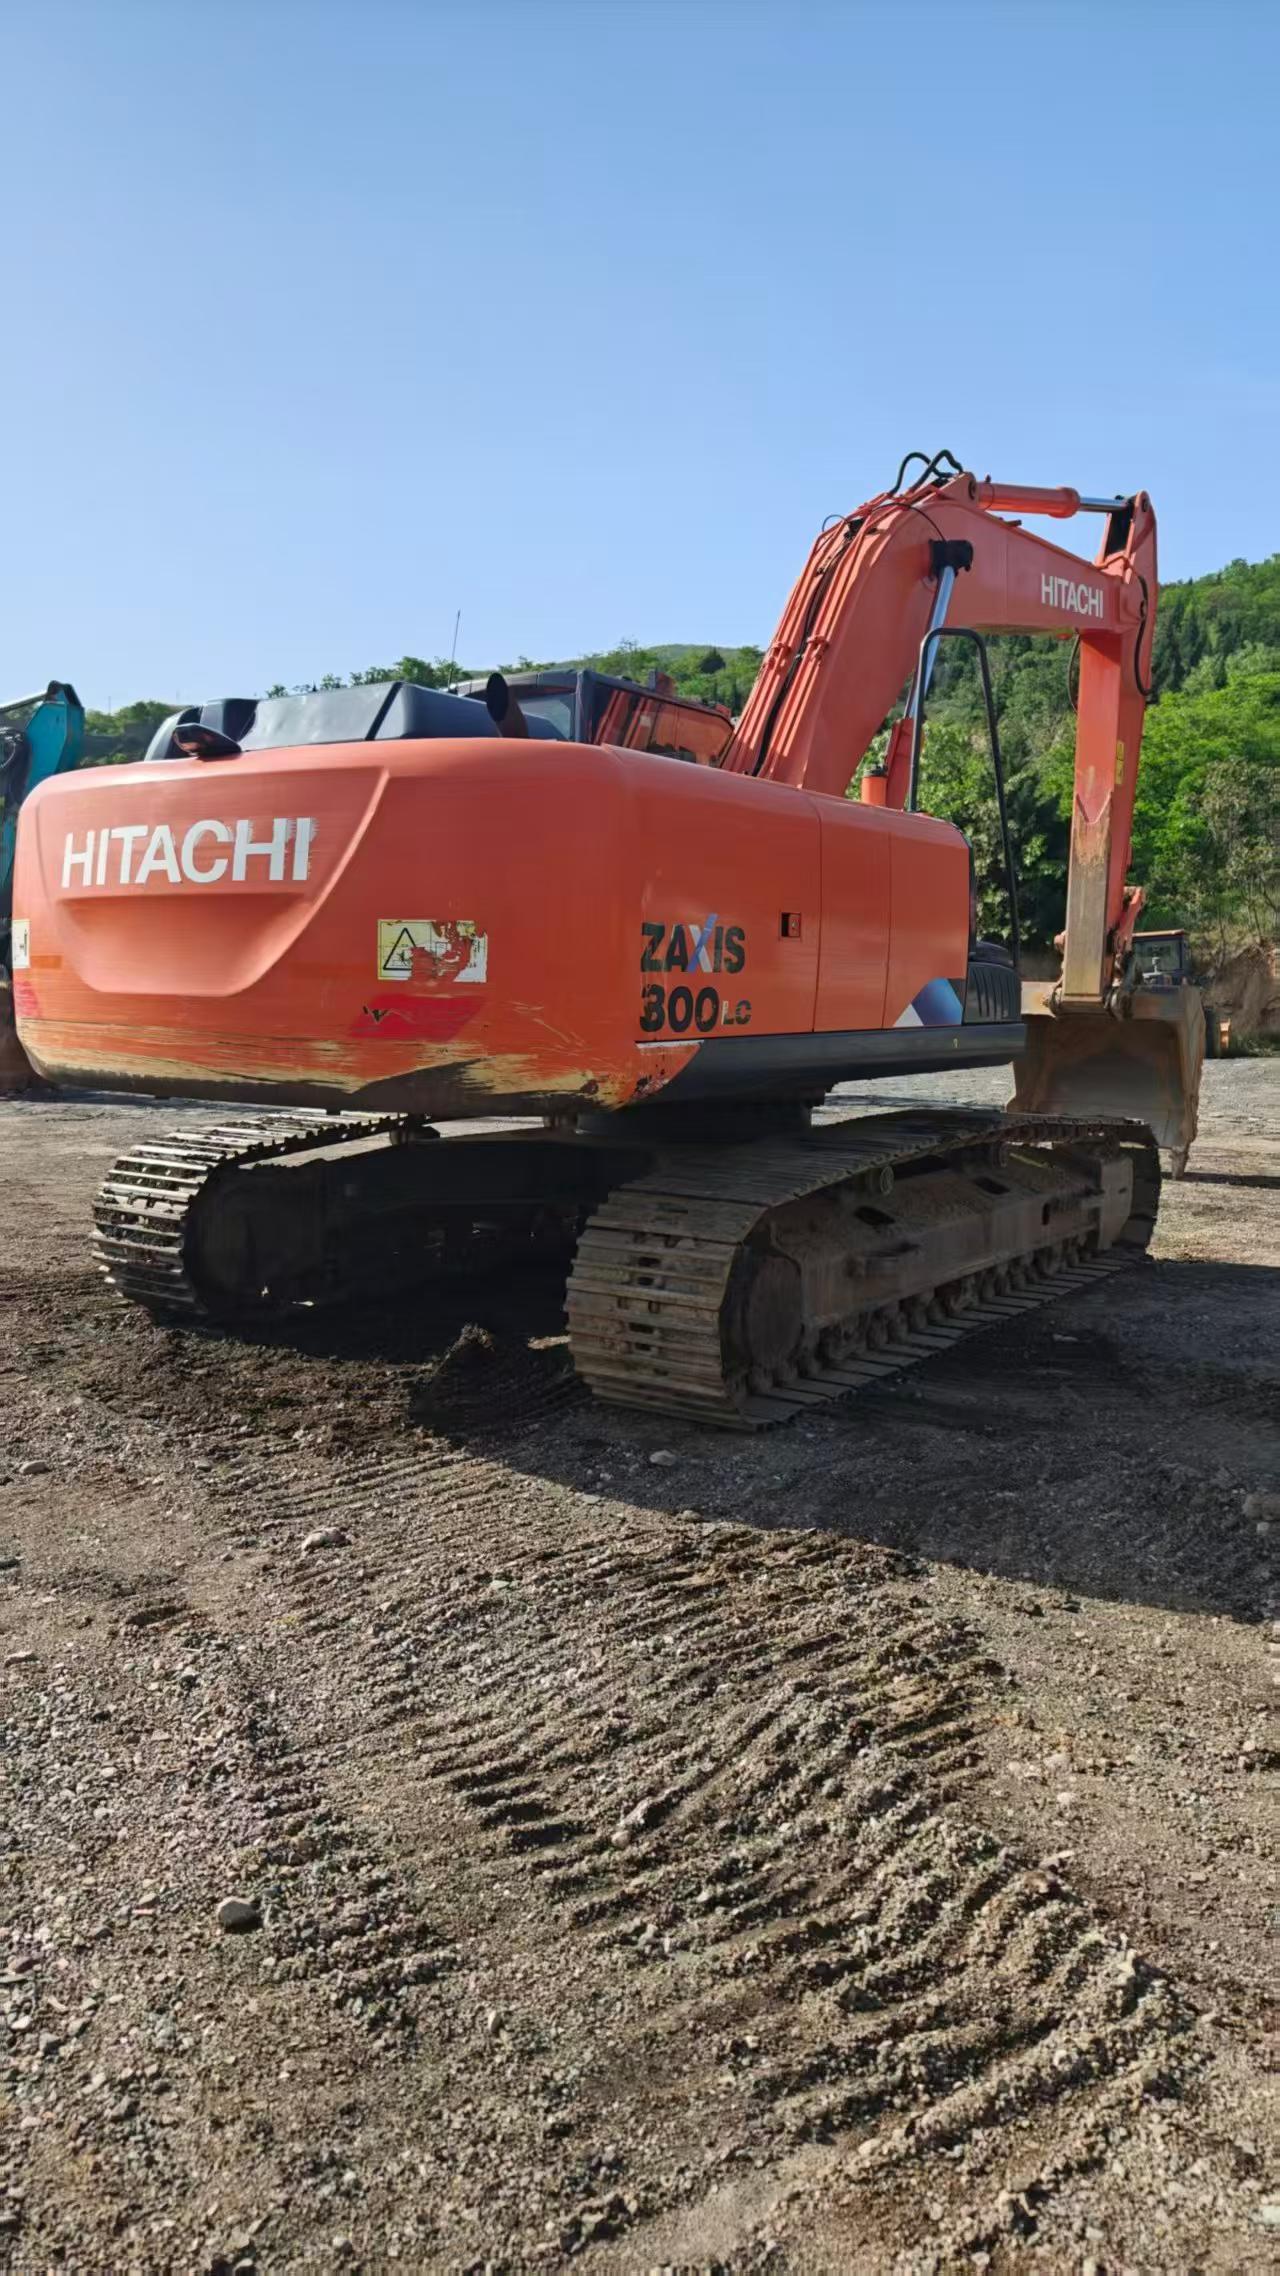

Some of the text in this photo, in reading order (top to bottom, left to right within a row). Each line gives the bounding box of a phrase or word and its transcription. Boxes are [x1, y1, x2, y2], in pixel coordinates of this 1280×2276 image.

[1041, 573, 1104, 619] HITACHI
[61, 817, 313, 888] HITACHI
[640, 912, 746, 974] ZAXIS
